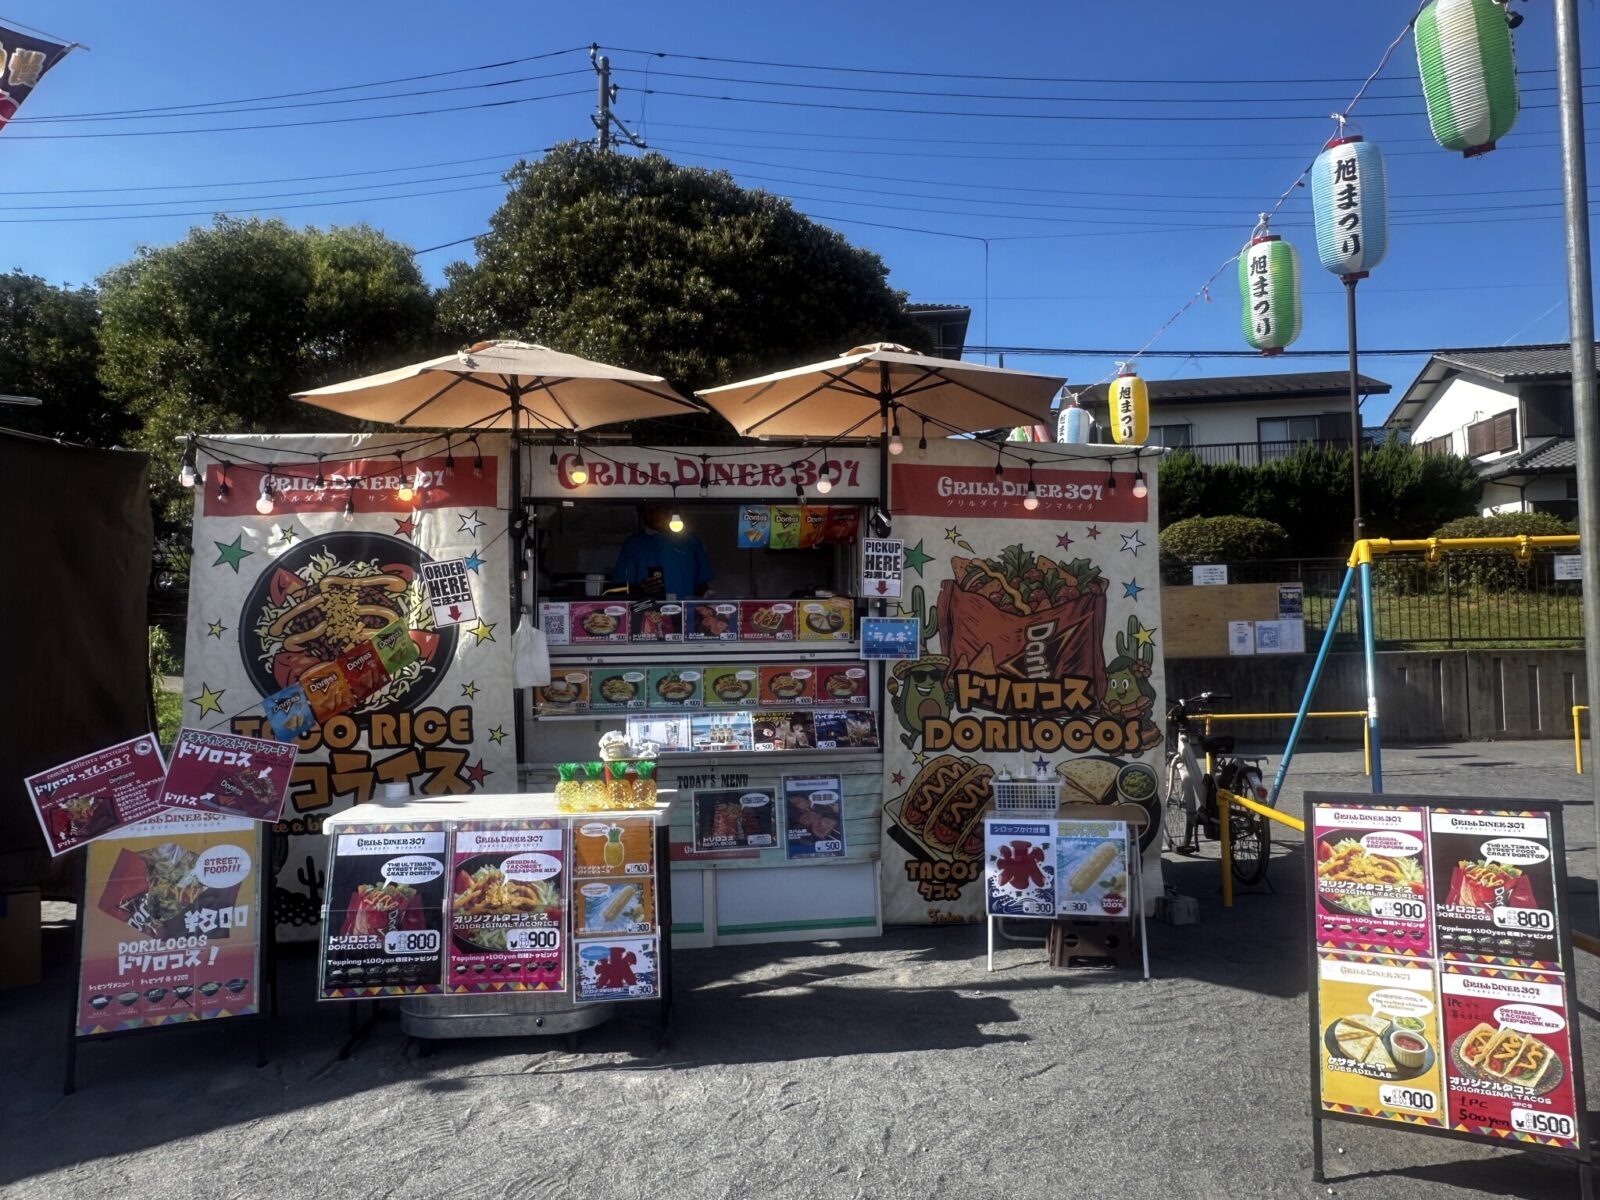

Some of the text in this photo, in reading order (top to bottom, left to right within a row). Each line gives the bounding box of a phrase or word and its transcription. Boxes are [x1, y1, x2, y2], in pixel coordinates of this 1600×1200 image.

[1335, 158, 1361, 256] 旭まつり
[1250, 255, 1271, 335] 旭まつり
[1119, 386, 1133, 439] 旭まつり
[557, 453, 670, 490] GRILL
[674, 457, 788, 487] DINER
[938, 476, 1000, 497] GRILL
[865, 542, 901, 554] PICKUP
[424, 561, 465, 580] ORDER
[865, 555, 901, 571] HERE
[428, 575, 469, 598] HERE
[379, 629, 403, 650] Doritos
[347, 652, 372, 671] Doritos
[310, 673, 338, 693] Doritos
[958, 675, 1090, 711] ドリロコス
[273, 694, 300, 713] Doritos
[234, 708, 470, 748] TCO RICE
[925, 719, 1139, 750] DORILOCOS
[178, 742, 253, 767] ドリロコス
[677, 774, 749, 789] TODAY'S MENU
[165, 792, 197, 806] ドリトス
[204, 857, 240, 866] STREET
[907, 862, 978, 880] TACOS
[920, 882, 959, 900] タコス
[185, 905, 249, 933] ¥800
[118, 935, 208, 955] DORILOCOS
[328, 943, 382, 951] DORILOCOS
[1463, 979, 1491, 989] GRILL
[1491, 983, 1520, 993] DINER
